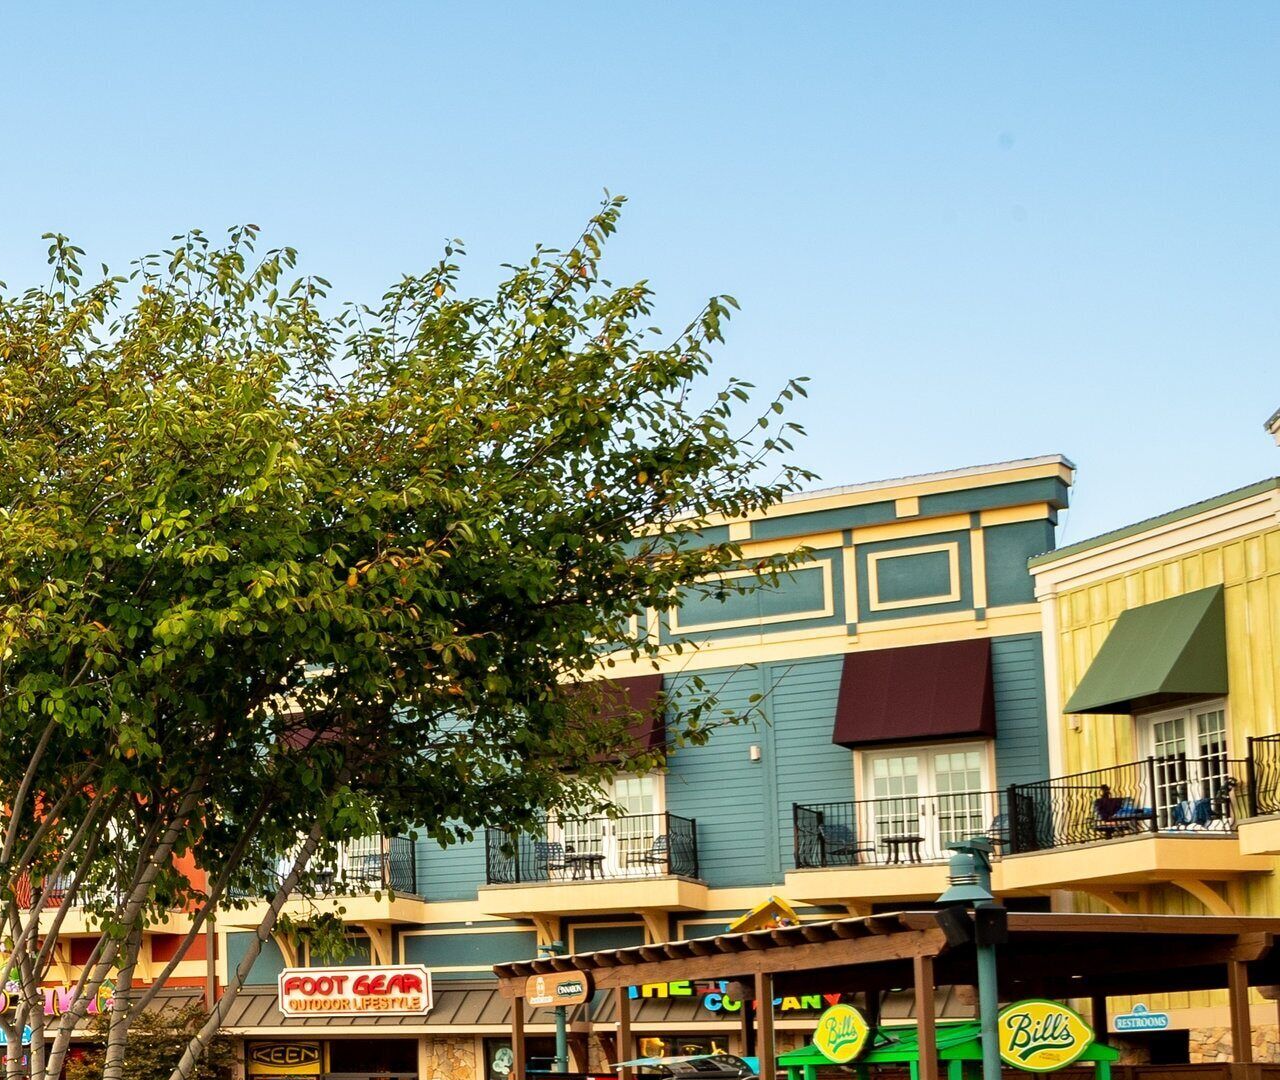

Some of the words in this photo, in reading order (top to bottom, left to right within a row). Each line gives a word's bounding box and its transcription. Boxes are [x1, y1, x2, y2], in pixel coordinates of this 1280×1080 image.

[285, 976, 348, 996] FOOT
[353, 974, 422, 996] GEAR
[289, 998, 351, 1011] OUTDOOR
[353, 997, 421, 1011] LIFESTYLE
[1117, 1017, 1166, 1028] RESTROOMS
[1007, 1013, 1074, 1051] Bill's
[253, 1047, 318, 1063] KEEN
